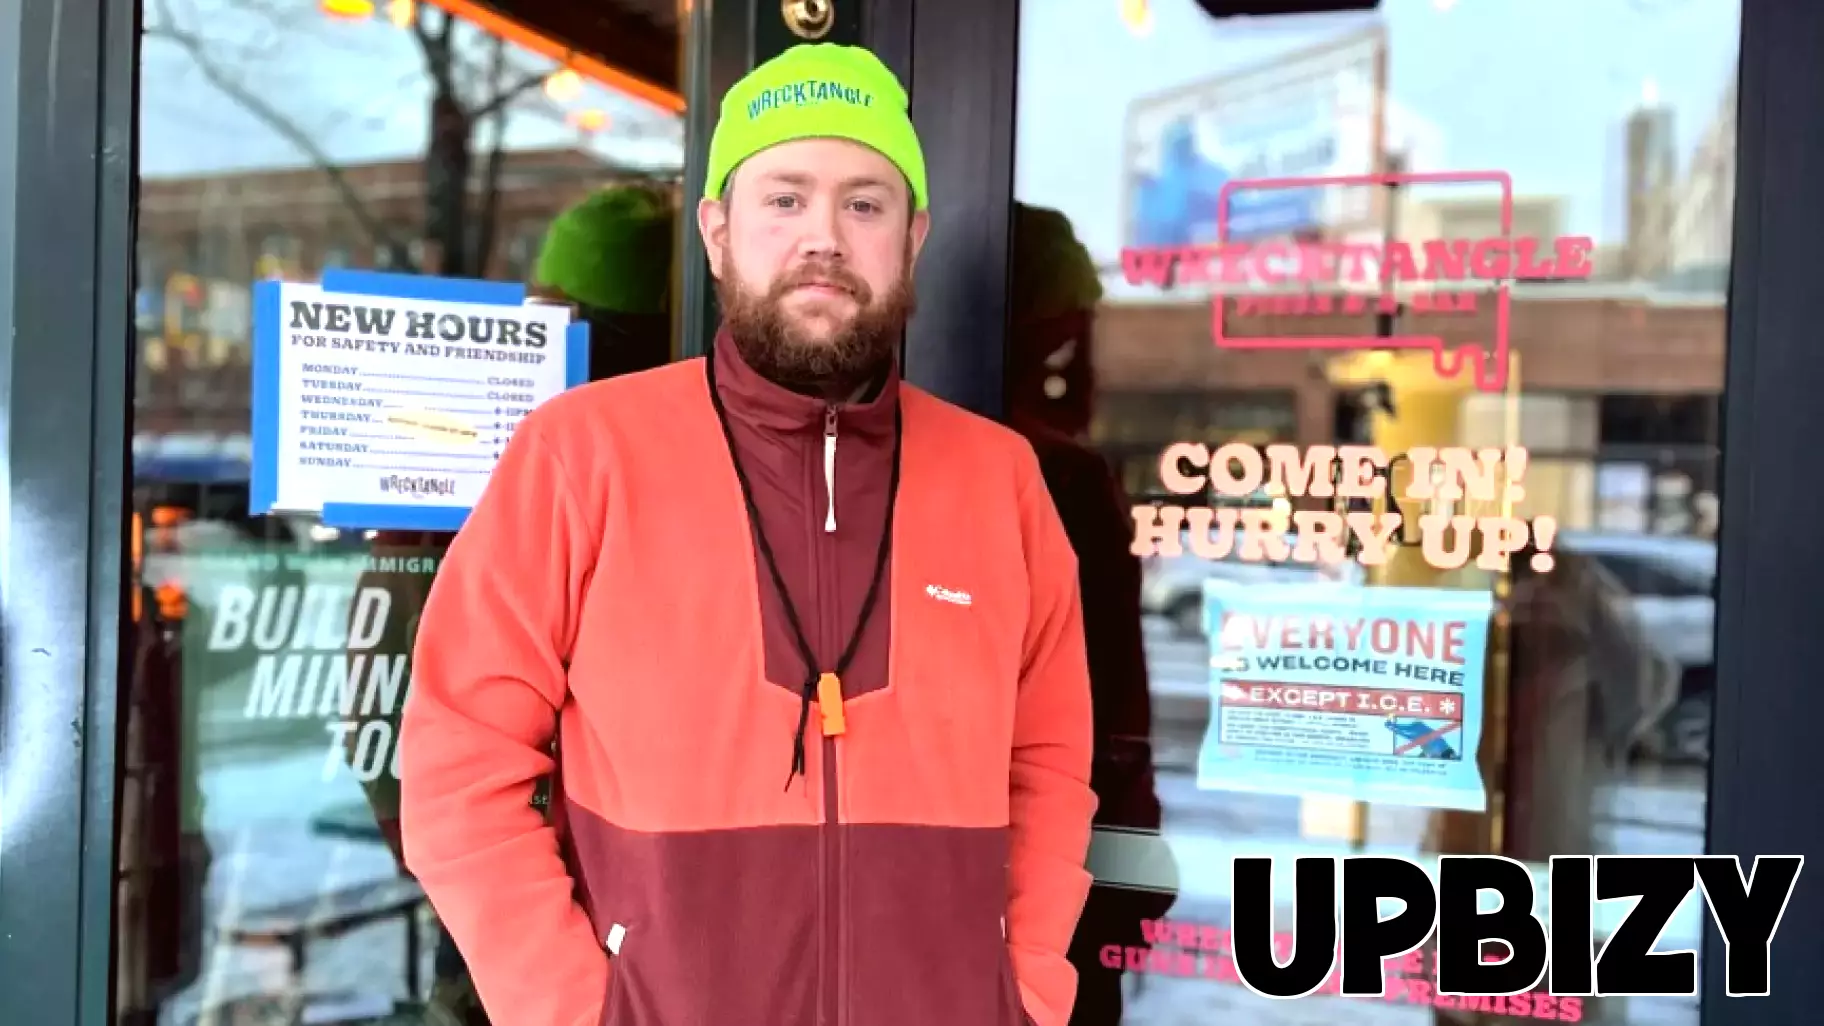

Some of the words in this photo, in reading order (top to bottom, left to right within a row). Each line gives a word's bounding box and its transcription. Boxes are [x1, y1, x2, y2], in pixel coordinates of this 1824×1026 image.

[1121, 236, 1593, 287] WRECKTANGLE
[290, 301, 396, 335] NEW
[405, 310, 547, 349] HOURS
[291, 334, 327, 348] FOR
[331, 338, 400, 353] SAFETY
[404, 342, 440, 356] AND
[445, 346, 546, 364] FRIENDSHIP
[302, 363, 358, 376] MONDAY
[302, 379, 362, 392] TUESDAY
[301, 395, 383, 408] WEDNESDAY
[299, 425, 348, 437] FRIDAY
[299, 441, 369, 453] SATURDAY
[299, 457, 352, 468] SUNDAY
[1160, 442, 1388, 496] COME
[1405, 445, 1527, 502] IN!
[1130, 505, 1402, 566] HURRY
[1418, 514, 1557, 573] UP!
[208, 585, 392, 651] BUILD
[1221, 611, 1468, 666] EVERYONE
[243, 654, 413, 718] MINN
[1256, 655, 1388, 676] WELCOME
[1394, 664, 1466, 687] HERE
[1249, 686, 1353, 711] EXCEPT
